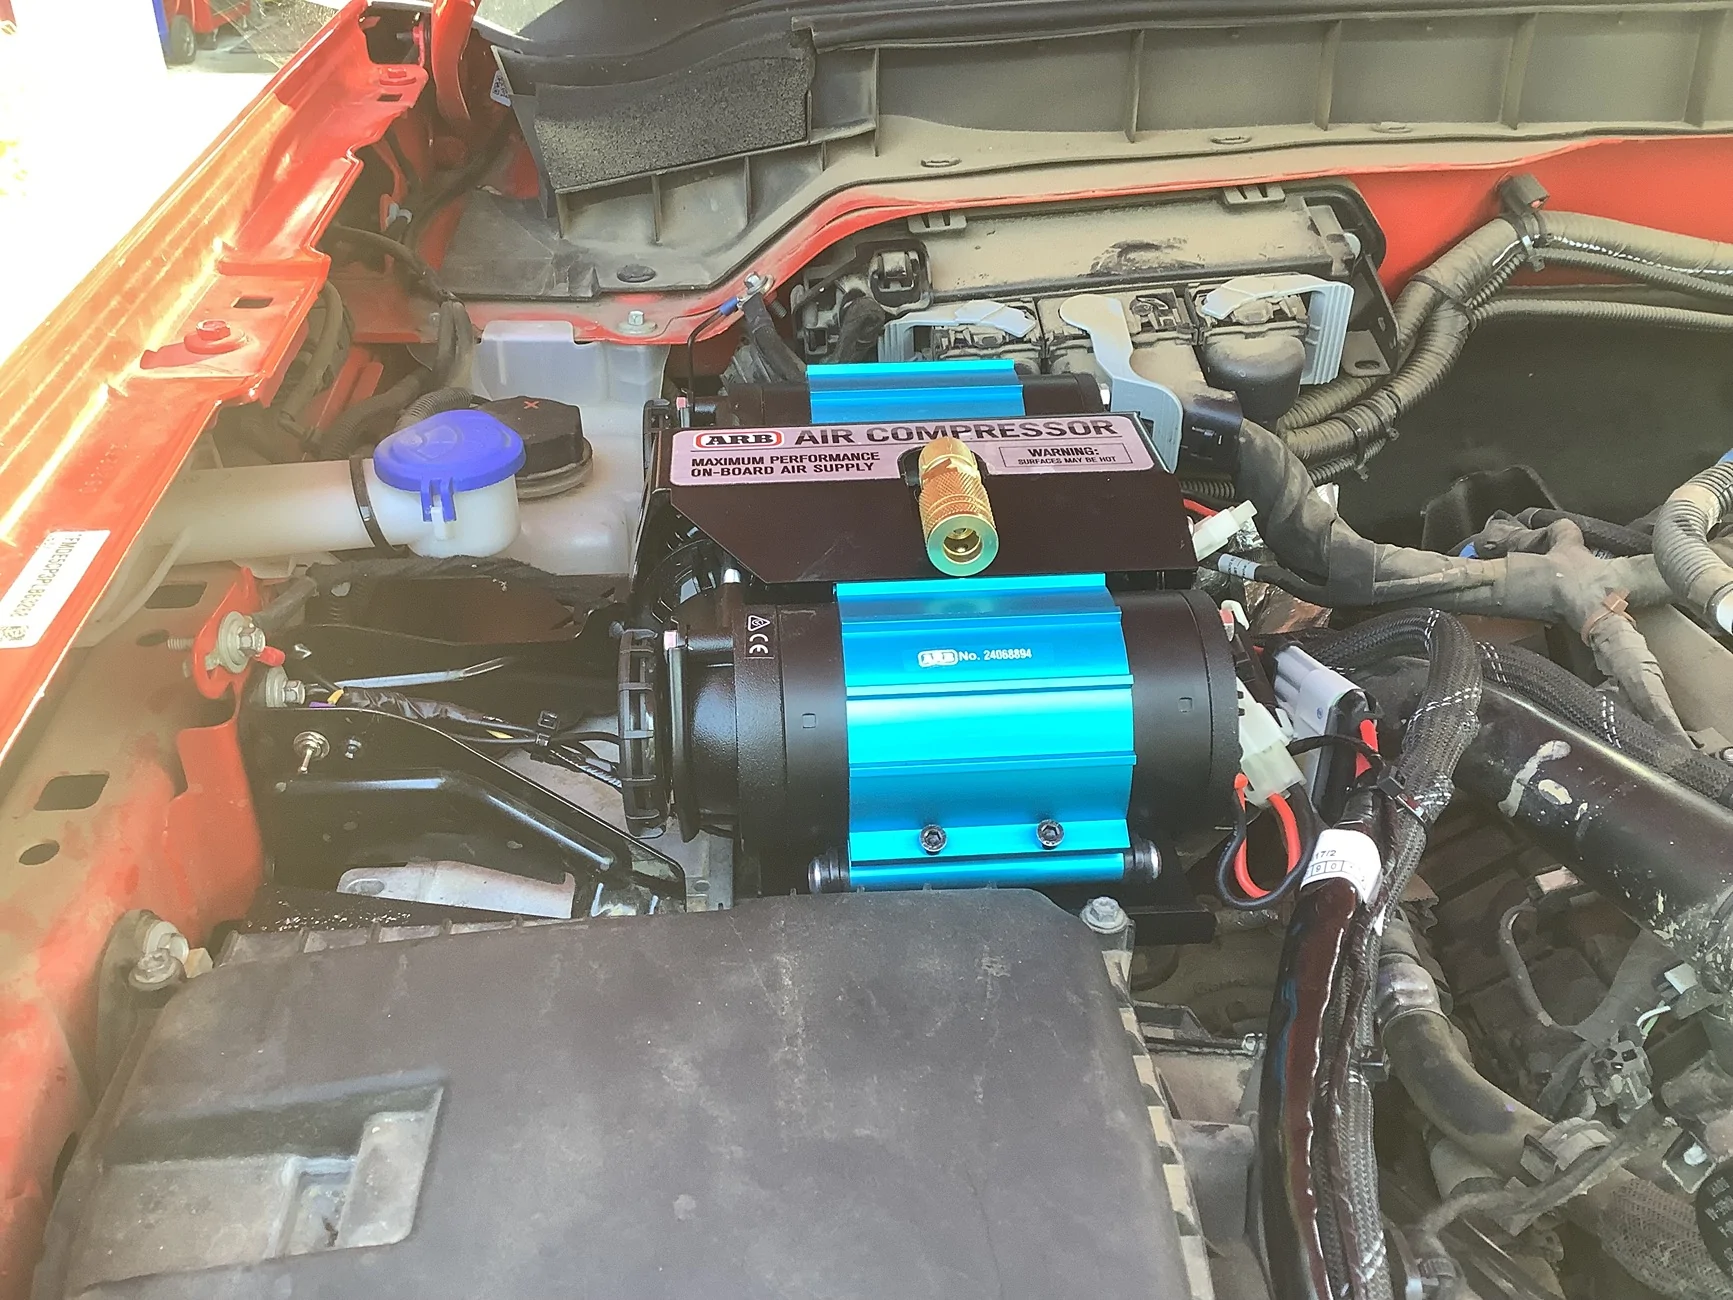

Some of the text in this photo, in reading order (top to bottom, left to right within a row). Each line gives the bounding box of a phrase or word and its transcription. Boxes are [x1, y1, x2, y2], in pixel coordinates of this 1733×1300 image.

[705, 420, 1118, 446] ARB AIR COMPRESSOR
[1027, 447, 1100, 457] WARNING:
[691, 452, 881, 467] MAXIMUM PERFORMANCE
[1017, 457, 1063, 465] SURFACES
[1099, 455, 1117, 463] HOT
[691, 462, 875, 477] ON-BOARD AIR SUPPLY
[958, 651, 981, 661] No.
[983, 648, 1033, 661] 24068894
